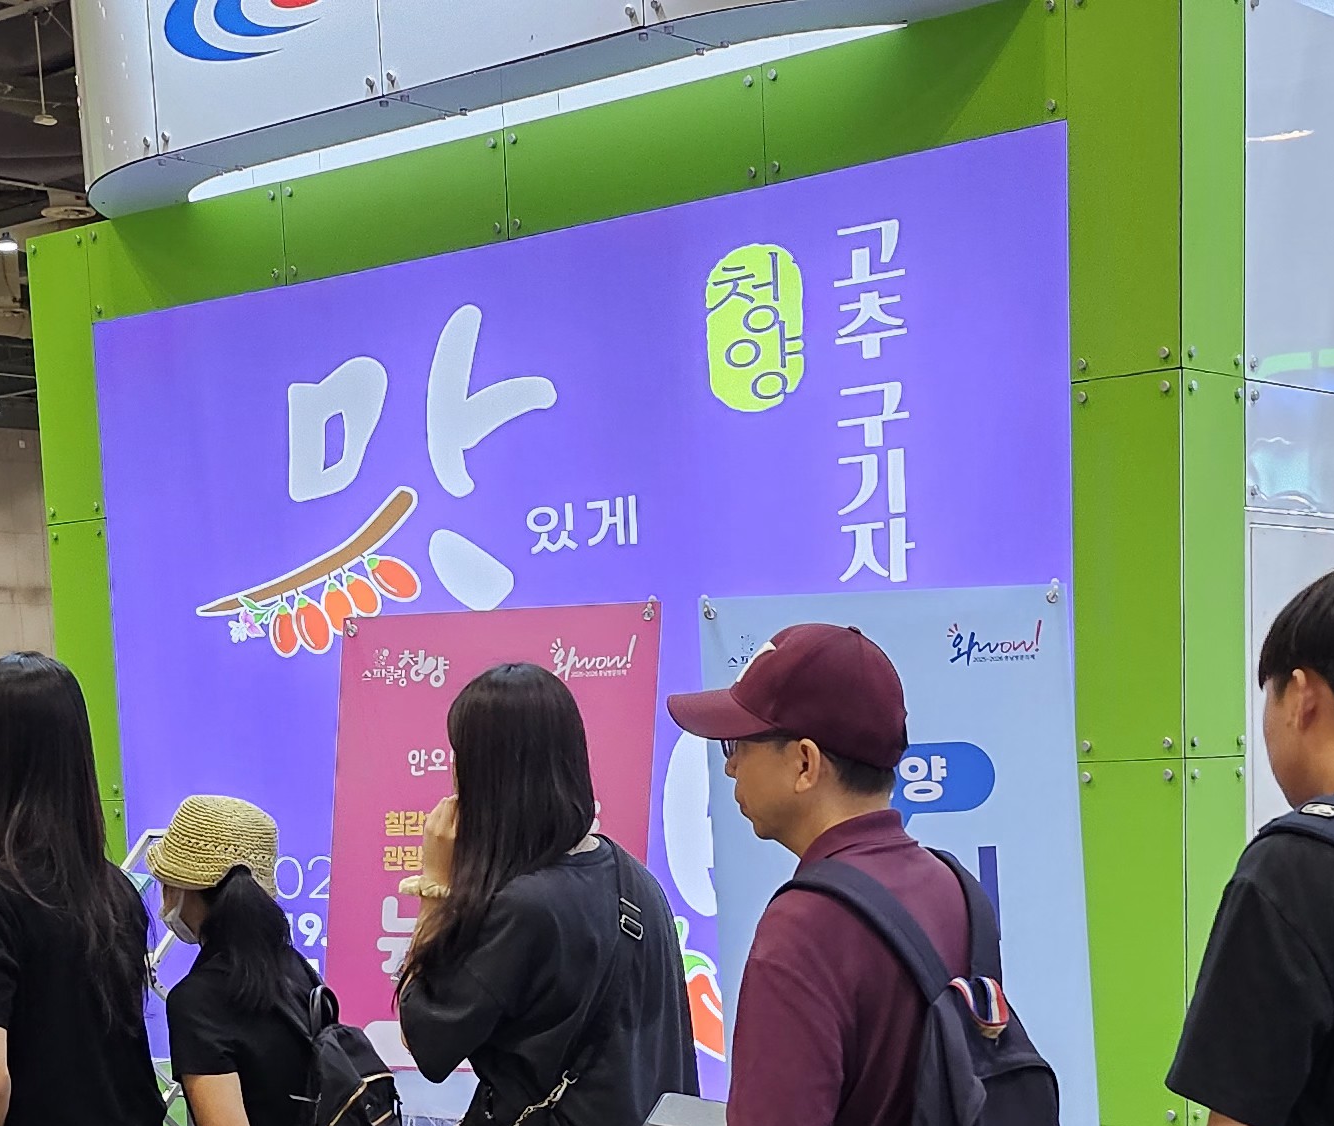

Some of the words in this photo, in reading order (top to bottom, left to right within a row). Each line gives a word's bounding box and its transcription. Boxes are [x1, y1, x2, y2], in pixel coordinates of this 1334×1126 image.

[706, 251, 804, 400] 청양
[833, 219, 908, 360] 고추
[288, 304, 558, 612] 맛
[525, 494, 639, 555] 있게
[836, 381, 916, 583] 구기자
[361, 663, 407, 688] 스파클링
[398, 649, 450, 688] 청양
[384, 811, 428, 837] 칠갑
[407, 748, 455, 777] 안오
